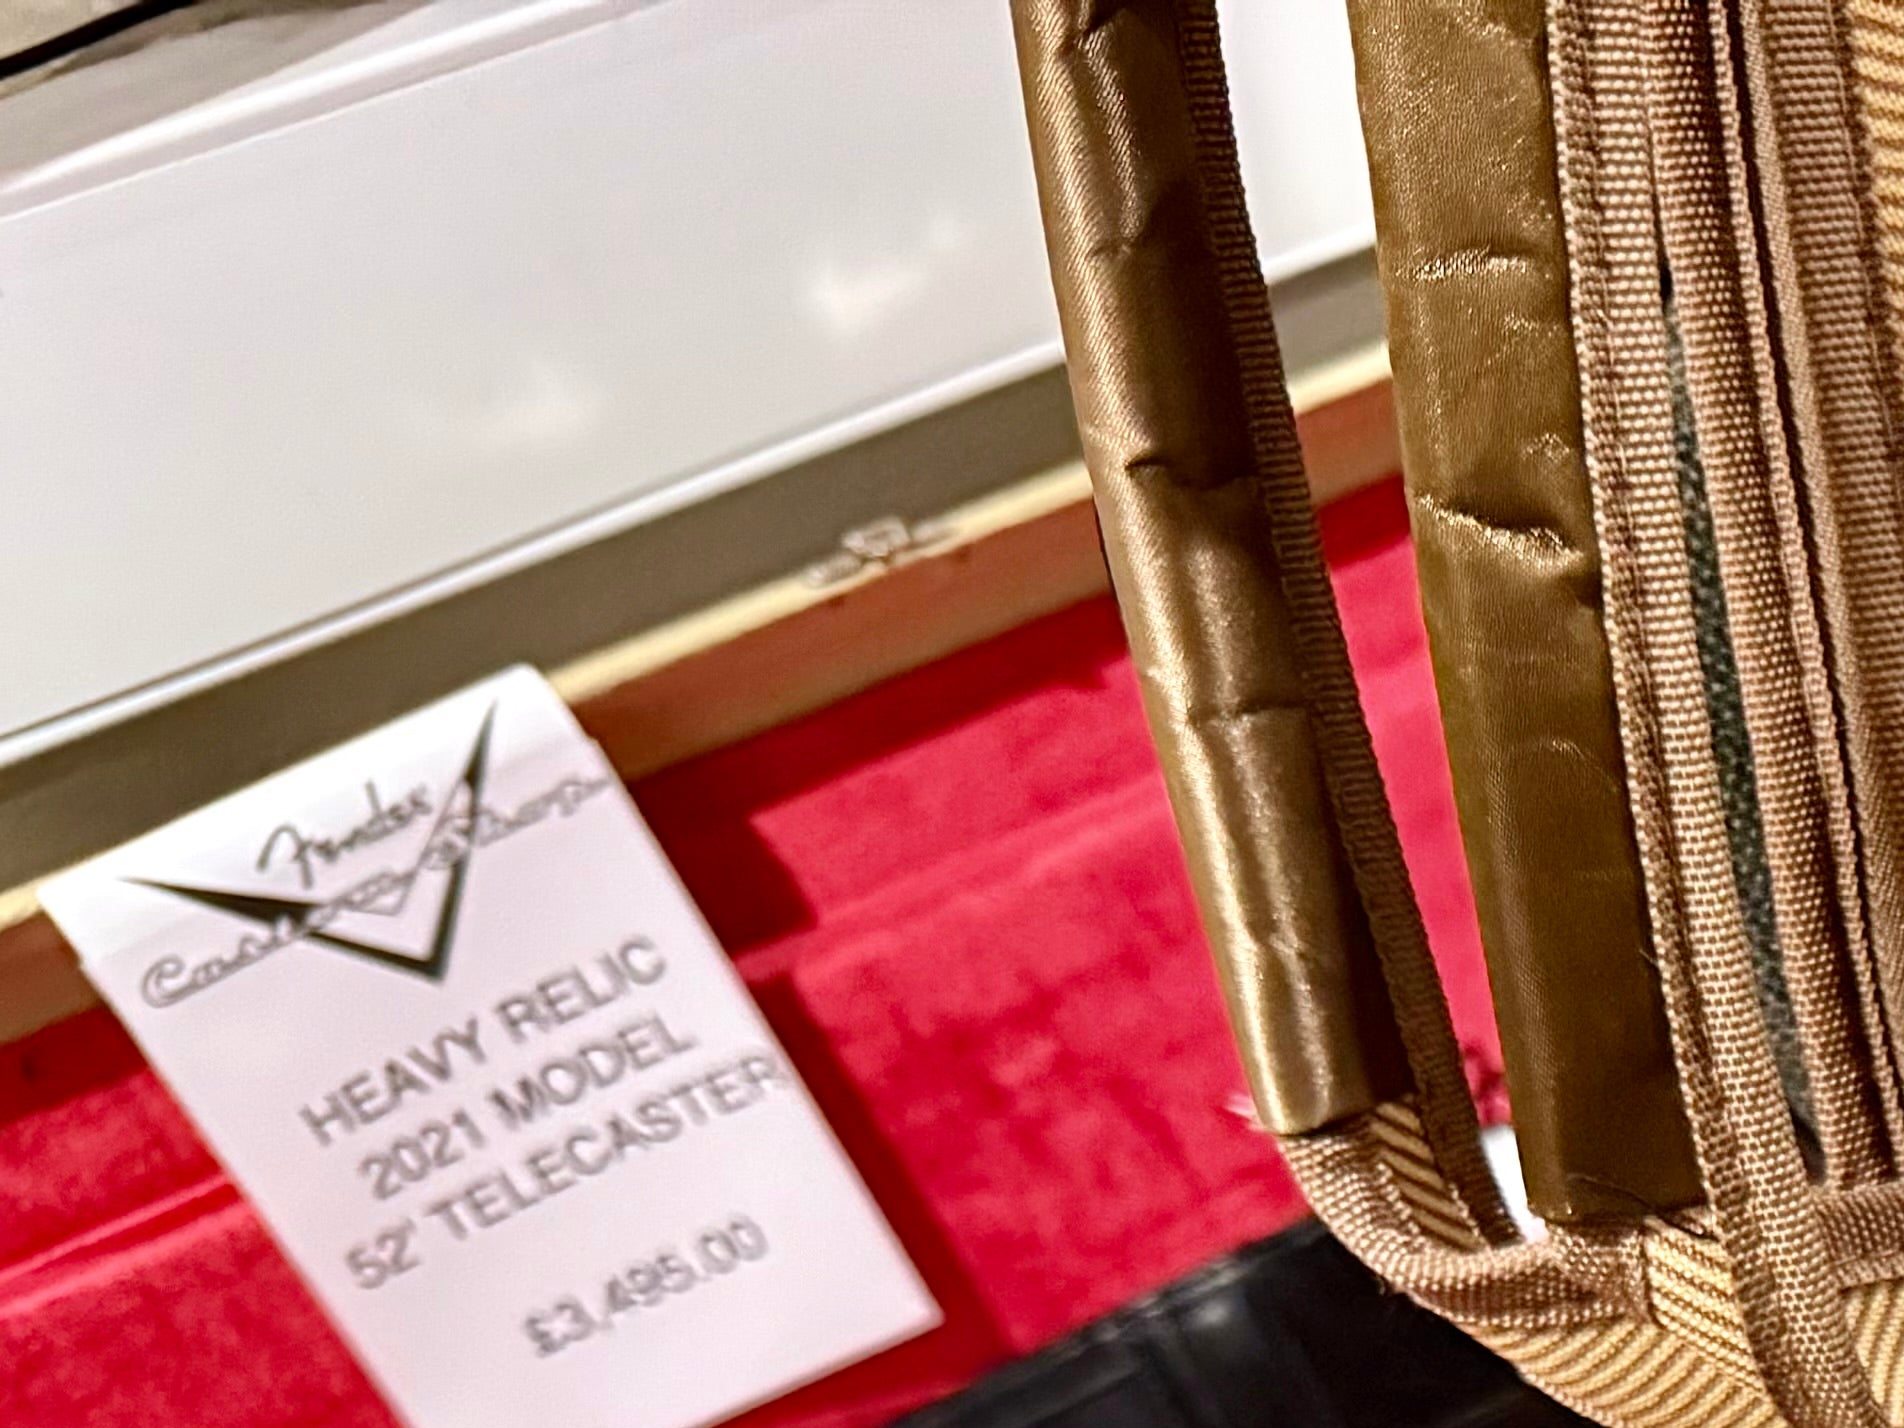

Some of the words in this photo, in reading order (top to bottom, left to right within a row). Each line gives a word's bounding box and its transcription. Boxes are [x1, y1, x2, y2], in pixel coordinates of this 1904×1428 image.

[257, 781, 432, 888] Fender
[142, 867, 418, 1009] Custom
[300, 1018, 487, 1147] HEAVY
[495, 934, 667, 1043] RELIC
[359, 1108, 487, 1200] 2021
[487, 1010, 698, 1129] MODEL
[424, 1053, 784, 1240] TELECASTER
[525, 1214, 769, 1358] £3,495.00
